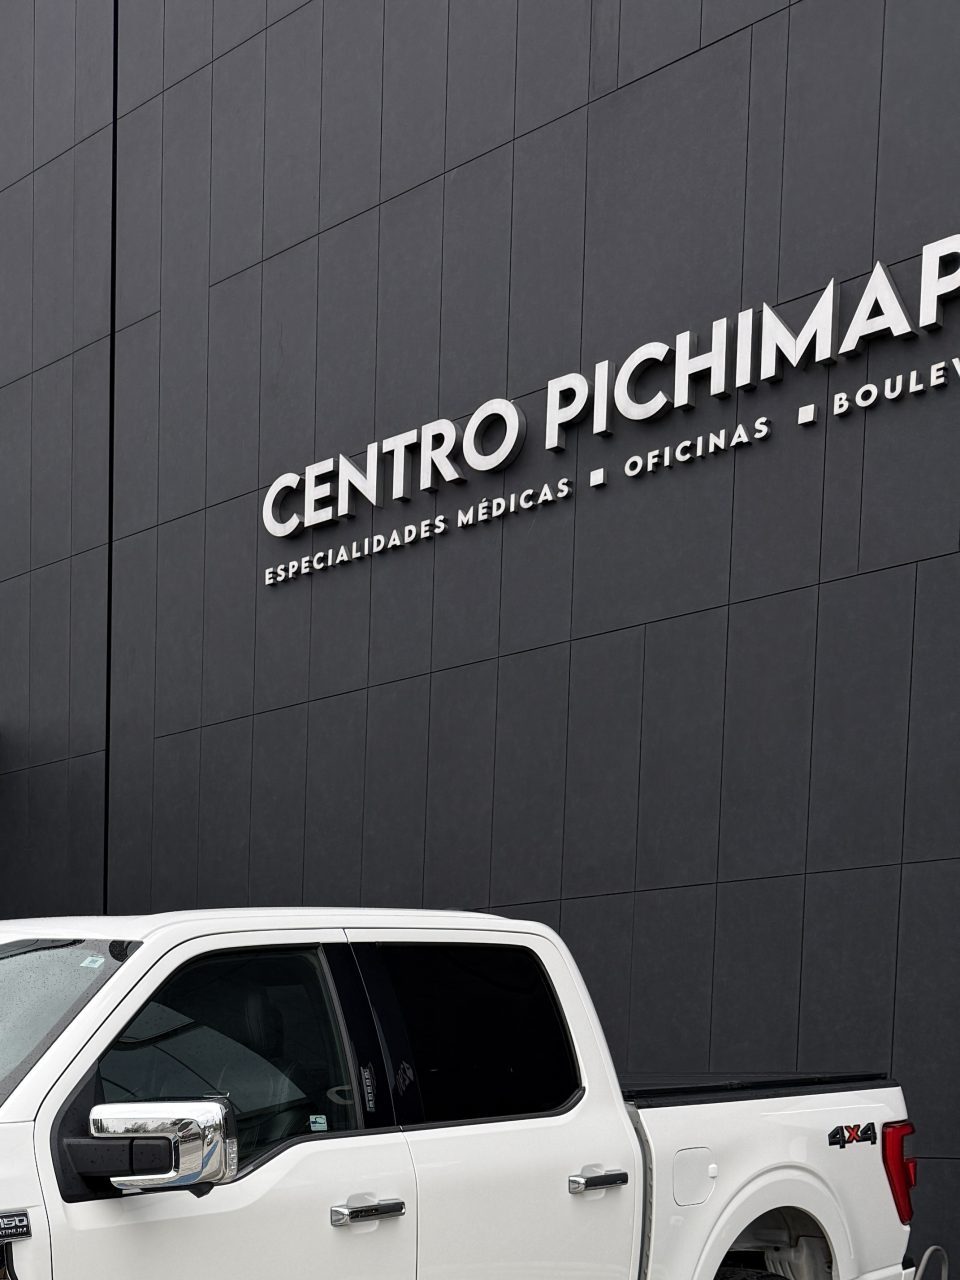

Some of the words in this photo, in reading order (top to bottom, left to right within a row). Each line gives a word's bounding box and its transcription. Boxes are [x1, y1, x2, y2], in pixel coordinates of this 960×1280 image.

[263, 398, 523, 538] CENTRO
[545, 233, 960, 450] PICHIMAP
[264, 515, 445, 586] ESPECIALIDADES
[457, 477, 570, 528] MÉDICAS
[624, 416, 770, 477] OFICINAS
